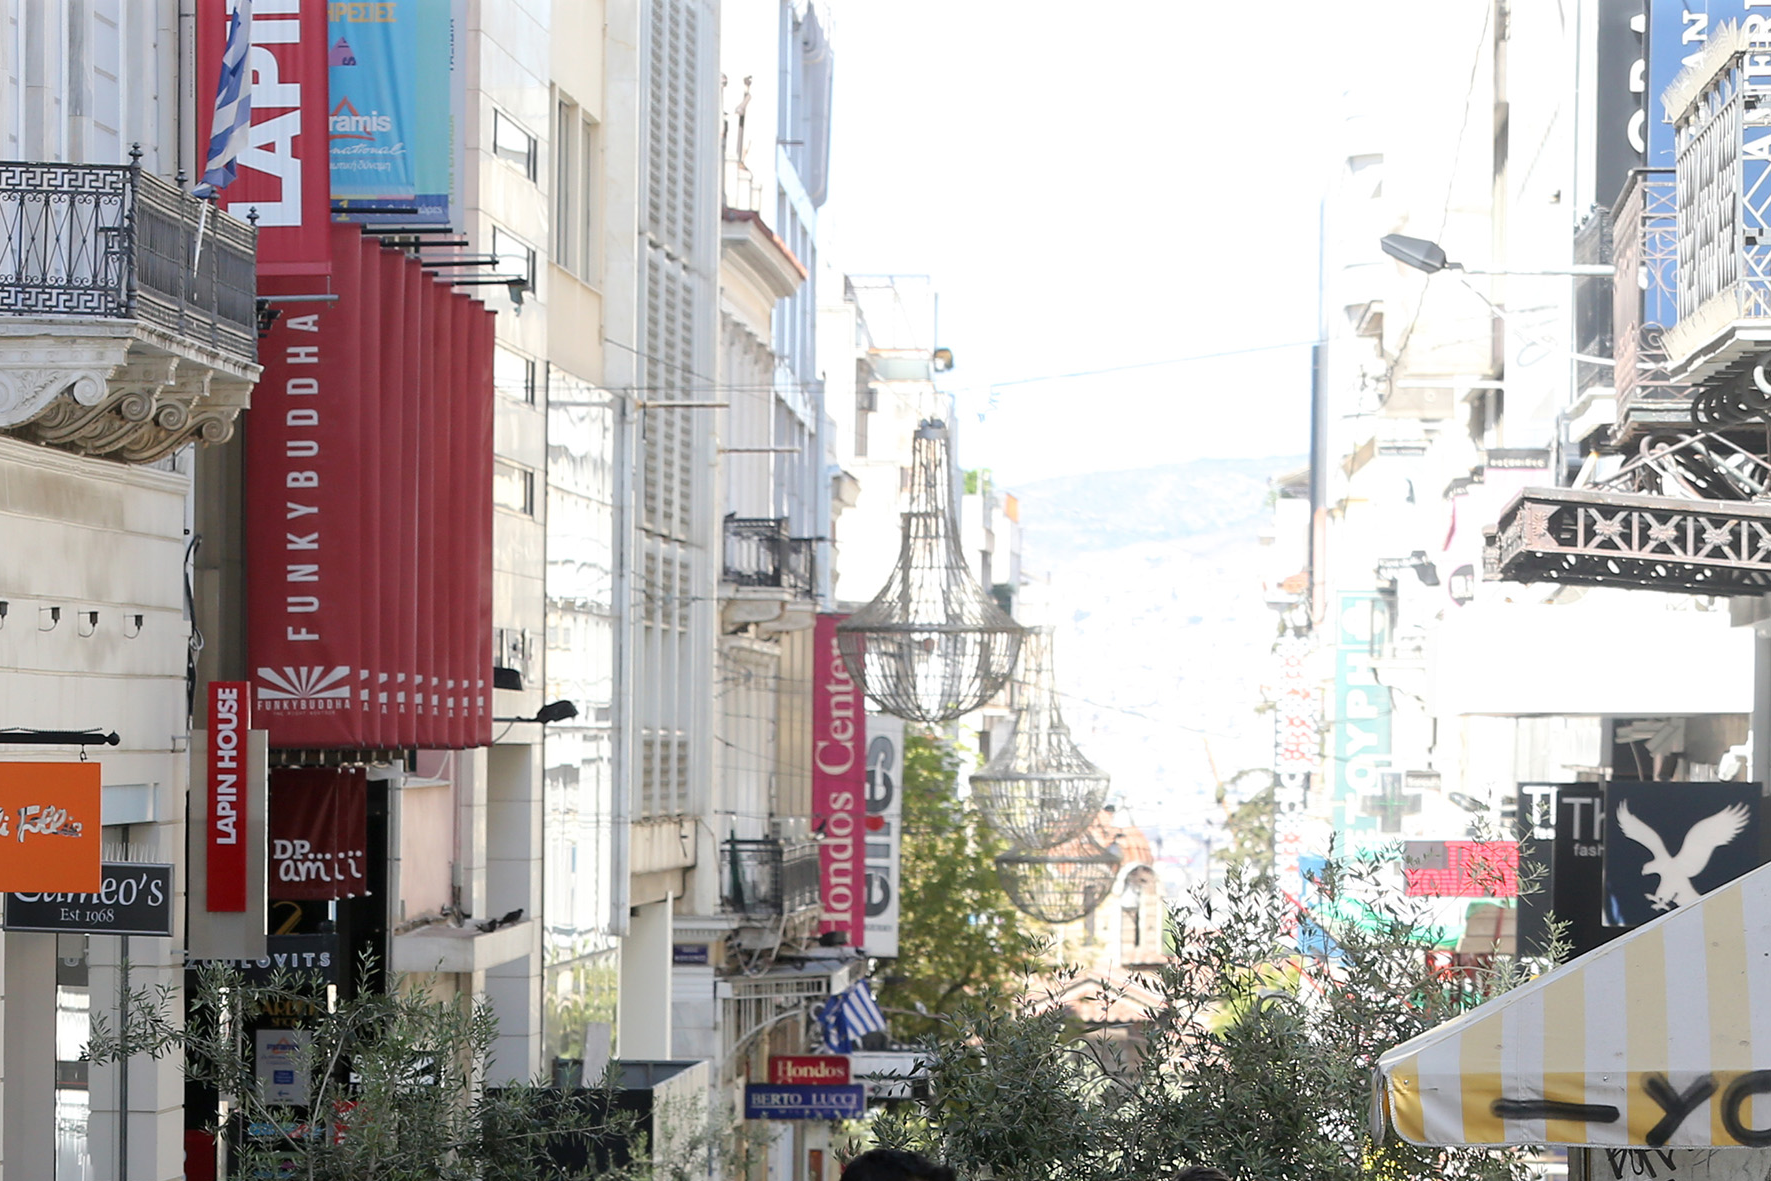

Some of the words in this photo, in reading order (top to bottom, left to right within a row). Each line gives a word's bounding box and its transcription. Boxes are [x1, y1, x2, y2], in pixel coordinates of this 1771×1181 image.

[329, 111, 391, 132] ramis
[330, 142, 406, 156] national
[286, 314, 320, 641] FUNKYBUDDHA
[257, 699, 350, 711] FUNKYBUDDHA
[814, 636, 855, 776] Center
[216, 687, 238, 768] HOUSE
[216, 773, 238, 845] LAPIN
[60, 908, 80, 922] Est
[85, 908, 115, 923] 1968
[777, 1060, 846, 1079] Hondos
